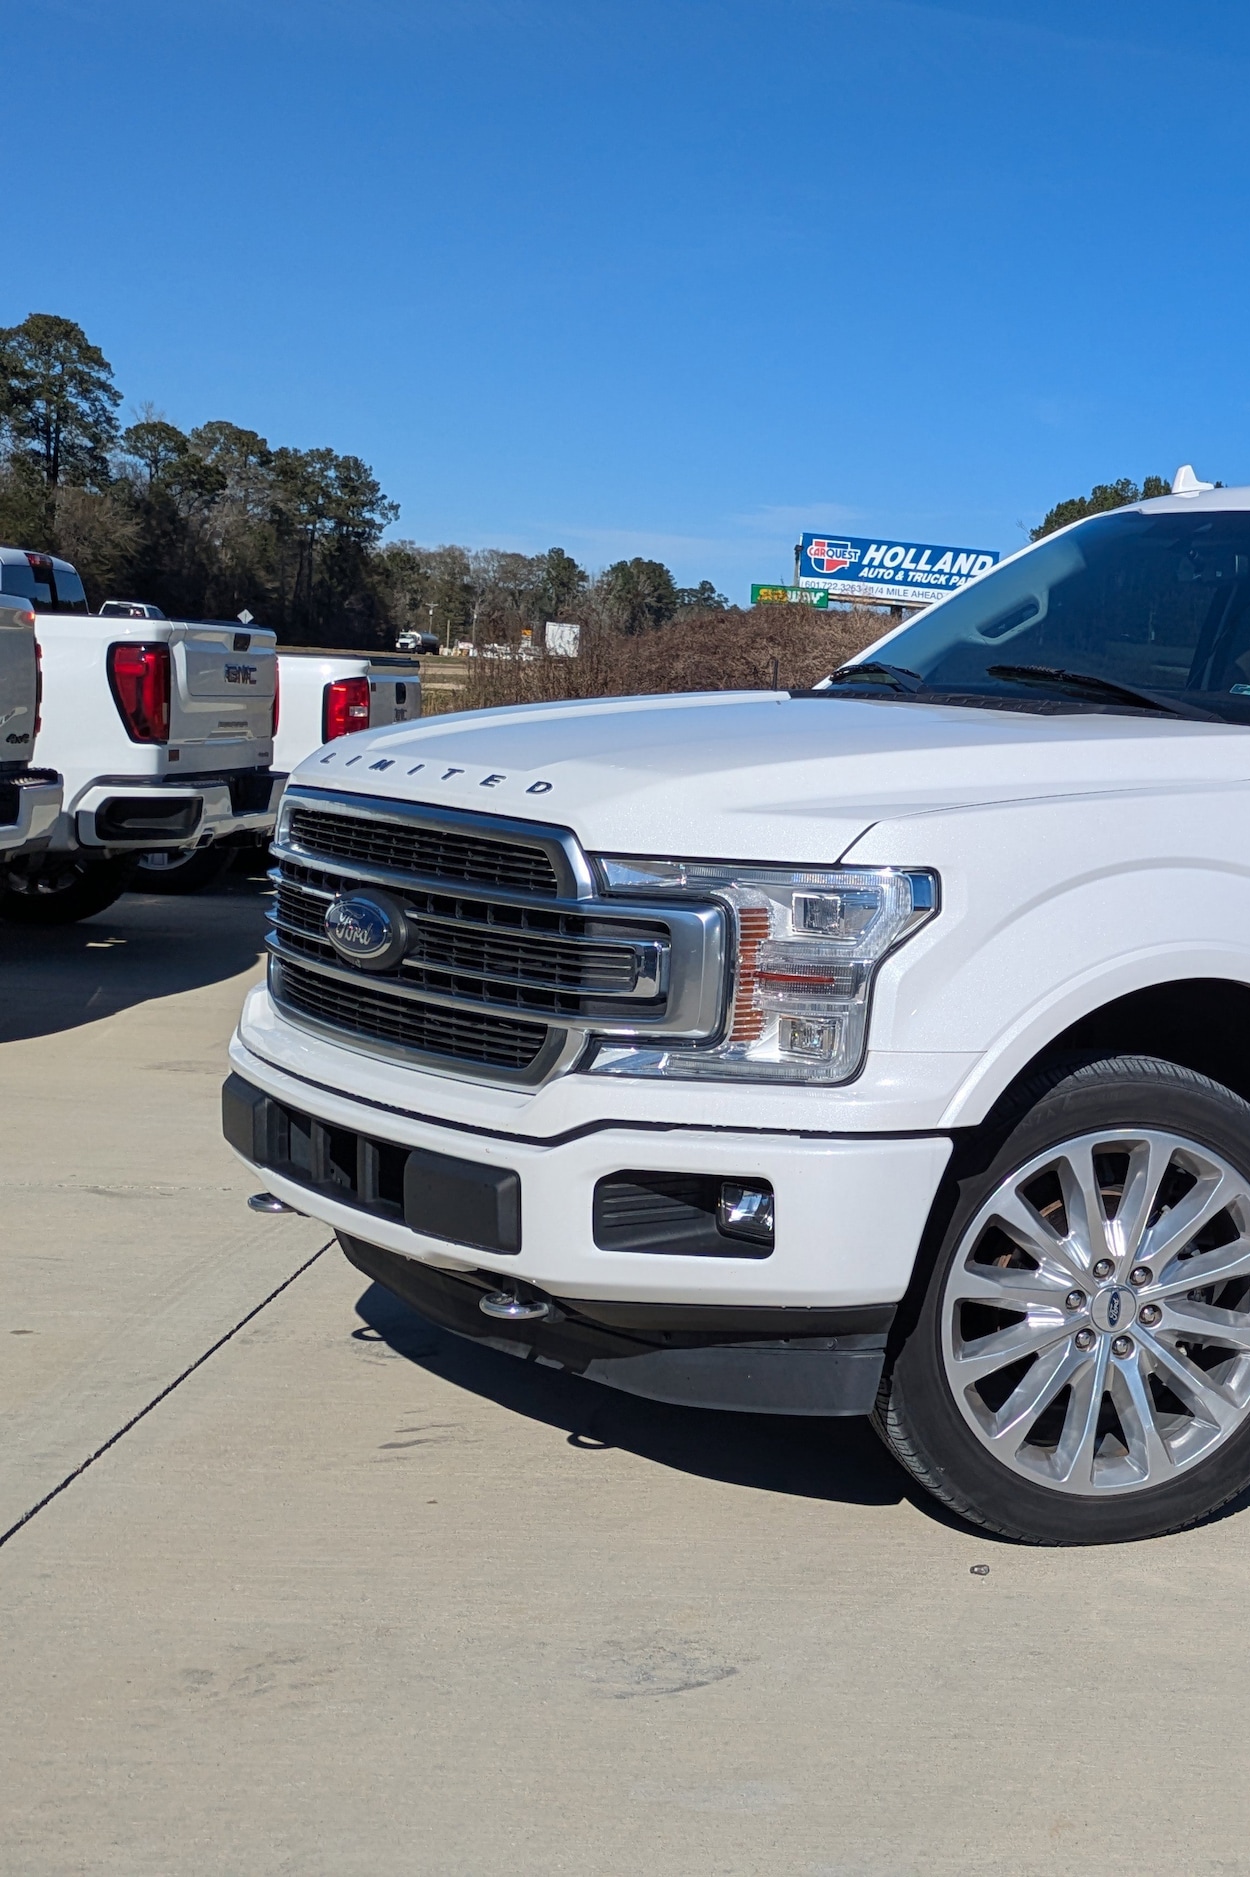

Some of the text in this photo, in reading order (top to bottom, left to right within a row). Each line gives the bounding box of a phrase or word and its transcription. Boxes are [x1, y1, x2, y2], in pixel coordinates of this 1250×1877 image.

[808, 547, 859, 561] CARQUEST
[861, 544, 994, 577] HOLLAND
[858, 567, 894, 580] AUTO
[895, 570, 905, 581] &
[907, 571, 949, 586] TRUCK
[886, 588, 909, 598] MILE
[911, 590, 944, 600] AHEAD
[319, 752, 554, 795] LIMITED
[336, 904, 374, 945] Ford
[1109, 1298, 1119, 1321] Ford
